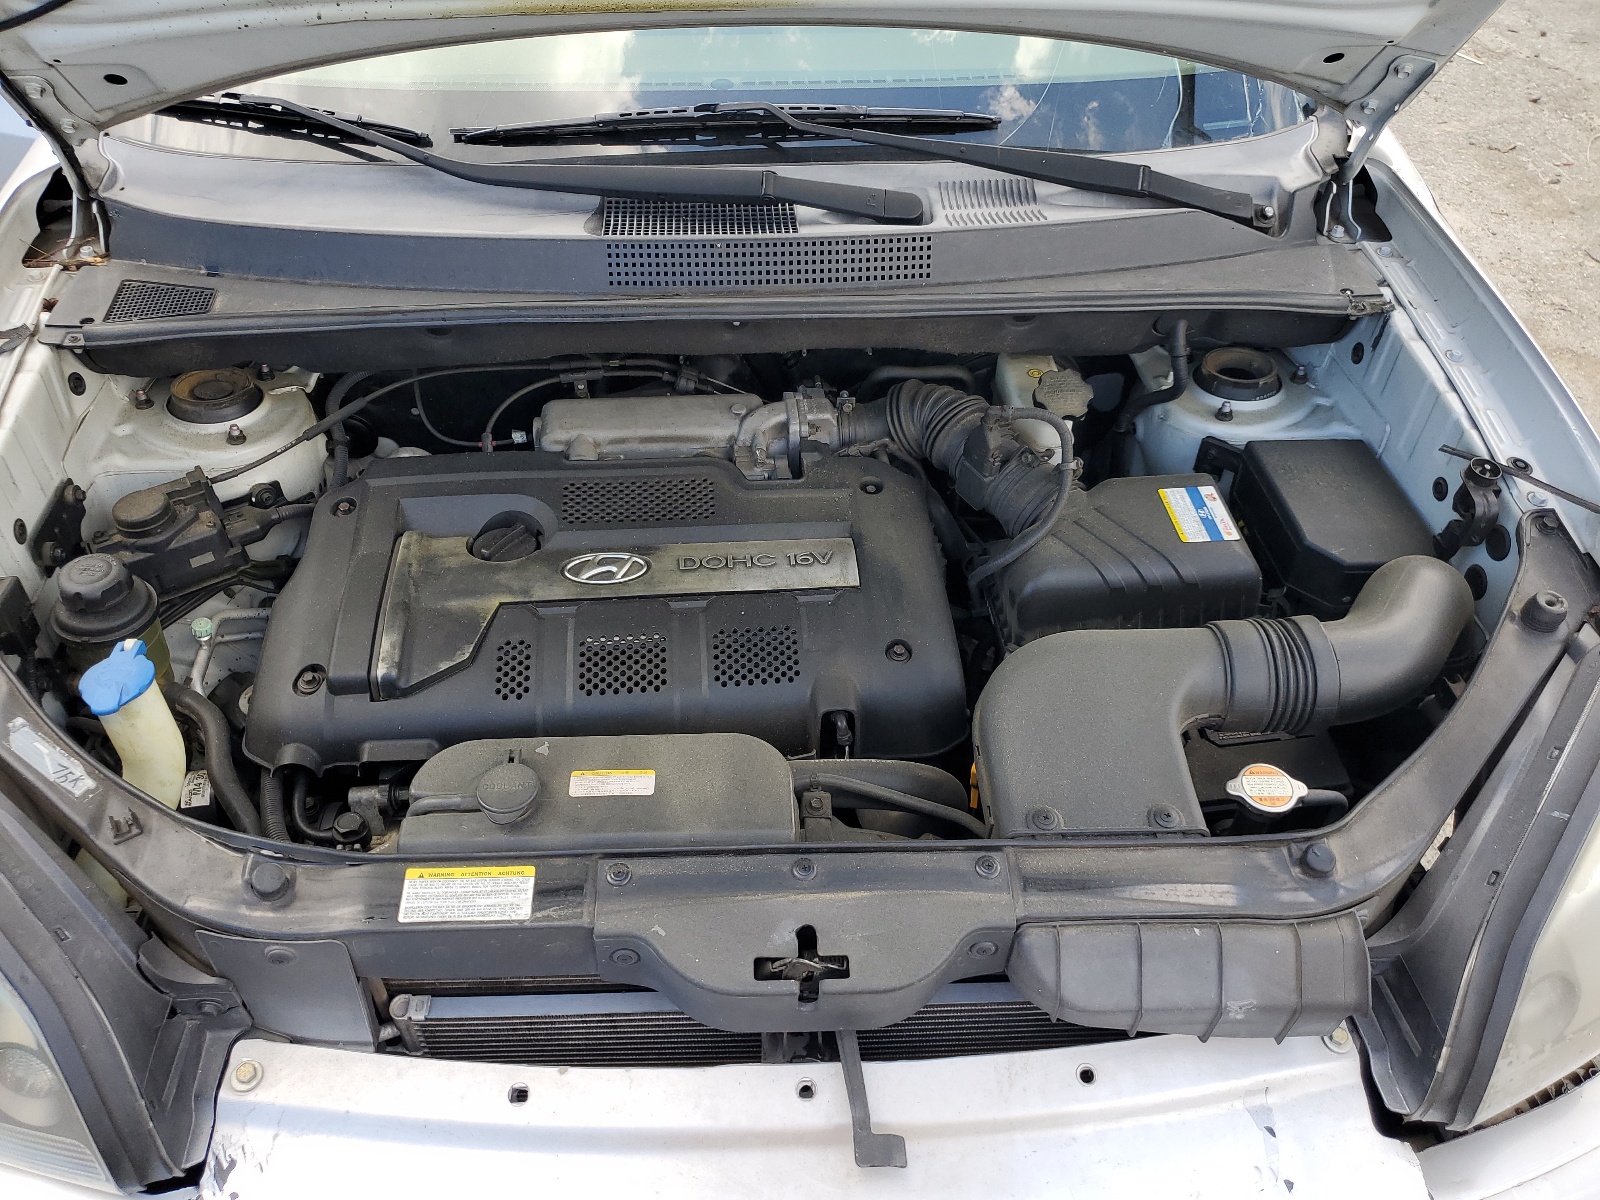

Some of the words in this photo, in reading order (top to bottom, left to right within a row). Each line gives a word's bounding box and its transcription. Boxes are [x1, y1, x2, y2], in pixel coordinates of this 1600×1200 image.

[678, 552, 776, 571] DOHC
[786, 550, 833, 566] 16V
[482, 781, 533, 790] COOLANT
